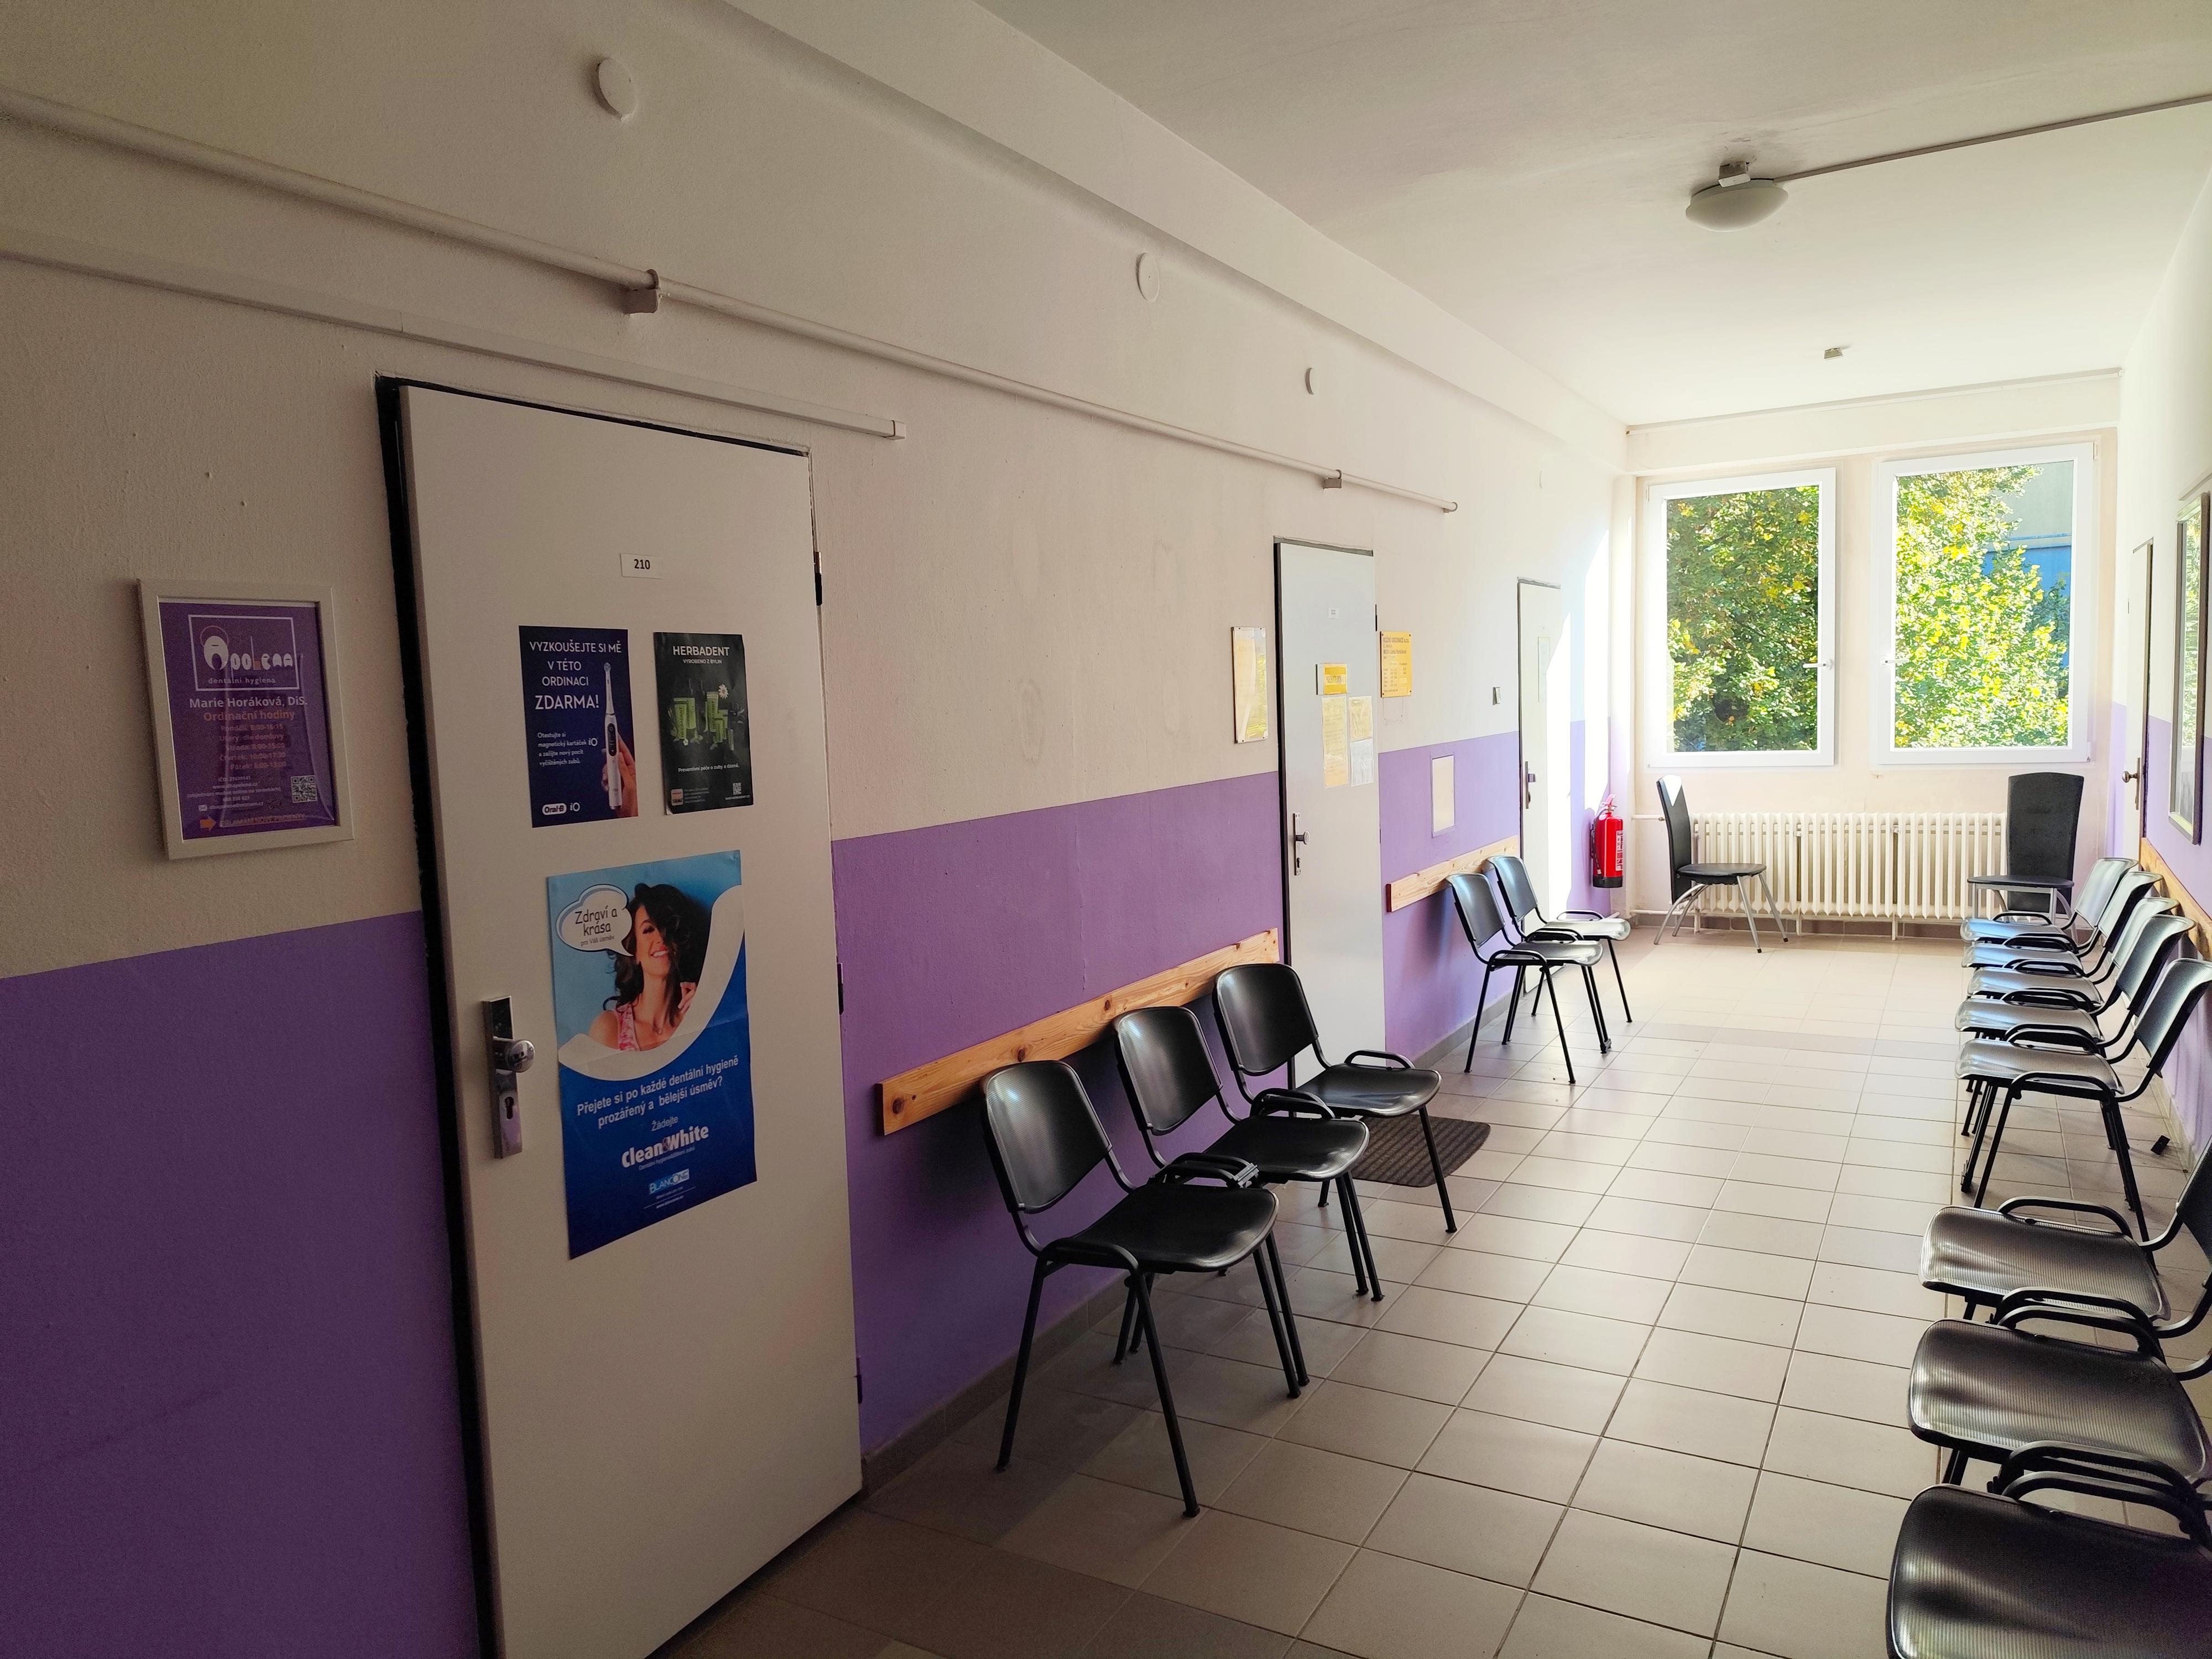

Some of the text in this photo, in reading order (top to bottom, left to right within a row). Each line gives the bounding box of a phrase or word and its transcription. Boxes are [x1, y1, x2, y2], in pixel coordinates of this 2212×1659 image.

[633, 558, 651, 570] 210
[529, 639, 622, 653] VYZKOUŠEJTE SI MĚ
[672, 645, 730, 656] HERBADENT
[547, 658, 582, 671] V TÉTO
[246, 677, 276, 686] hygiena
[542, 676, 589, 686] ORDINACI
[189, 696, 308, 708] Marie Horáková, DiS.
[535, 695, 599, 709] ZDARMA!
[203, 709, 295, 722] Ordinační hodiny
[538, 740, 566, 749] magnetický
[544, 805, 565, 813] Oral-B
[575, 905, 618, 924] Zdraví a
[583, 920, 611, 936] krása
[577, 1055, 739, 1116] Přejete si po každé dentální hygieně
[598, 1076, 723, 1129] prozářený a bělejší úsměv?
[651, 1116, 679, 1132] Žádejte
